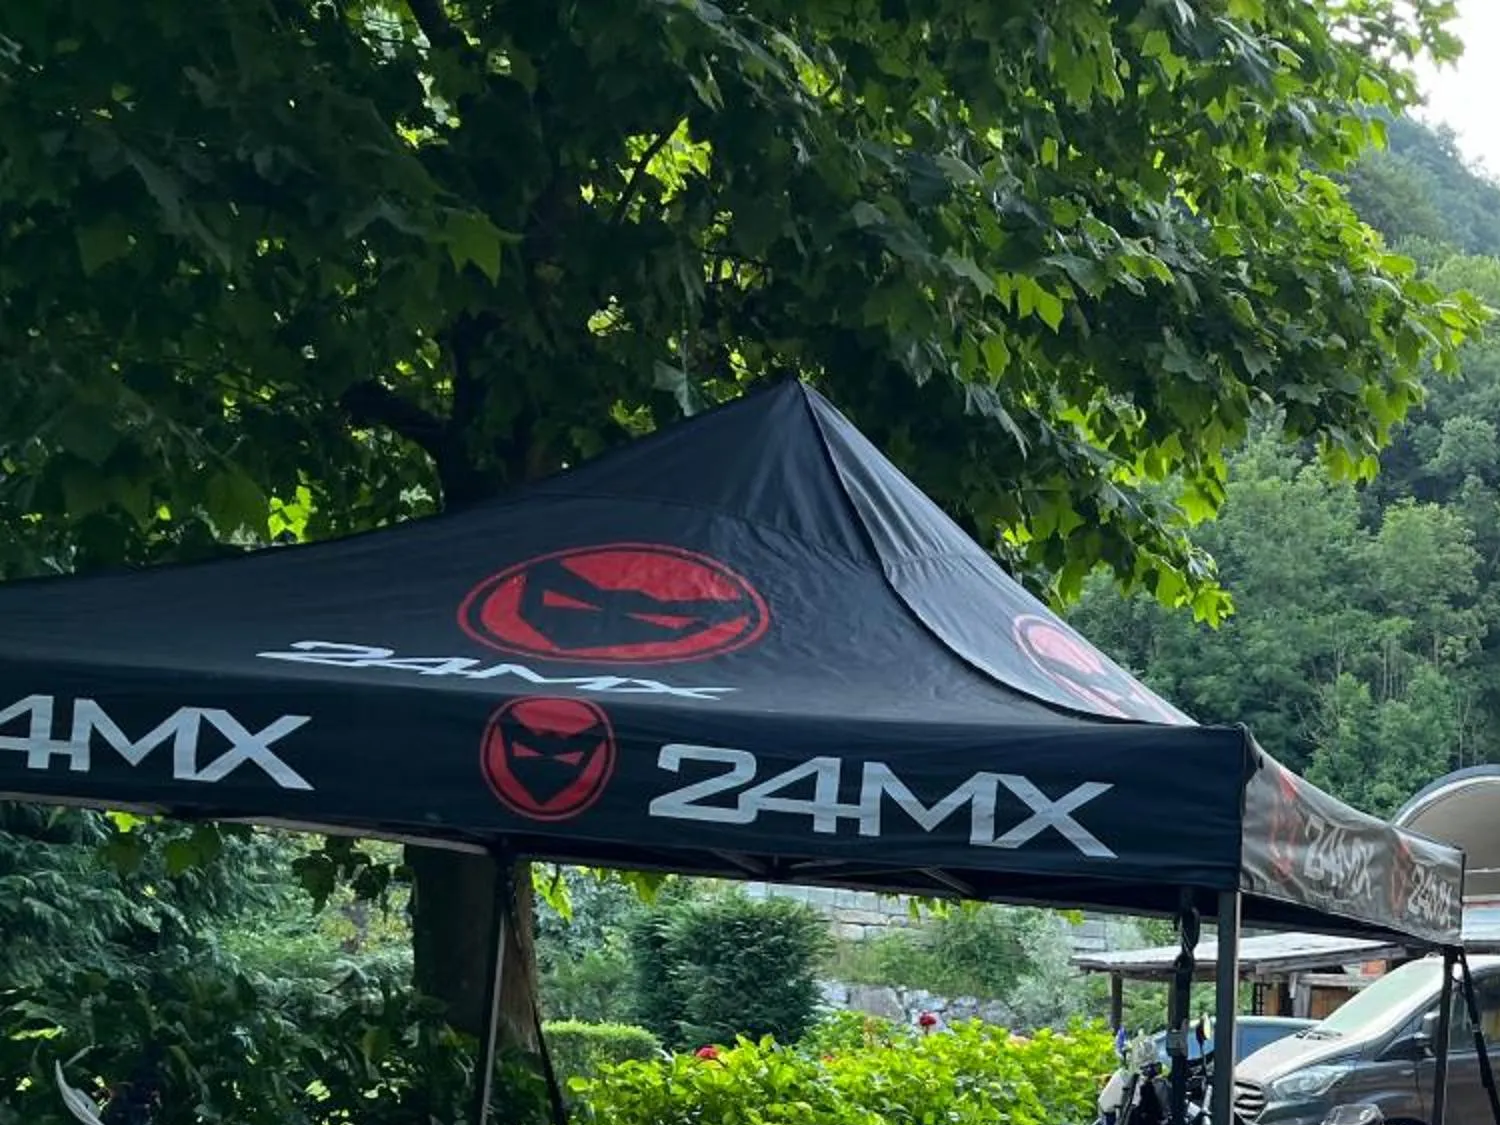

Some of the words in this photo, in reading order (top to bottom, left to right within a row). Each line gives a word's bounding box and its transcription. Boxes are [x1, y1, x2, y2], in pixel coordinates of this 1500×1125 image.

[256, 641, 736, 700] 24MX
[649, 745, 1118, 858] 24MX
[1304, 815, 1375, 899] 24MX
